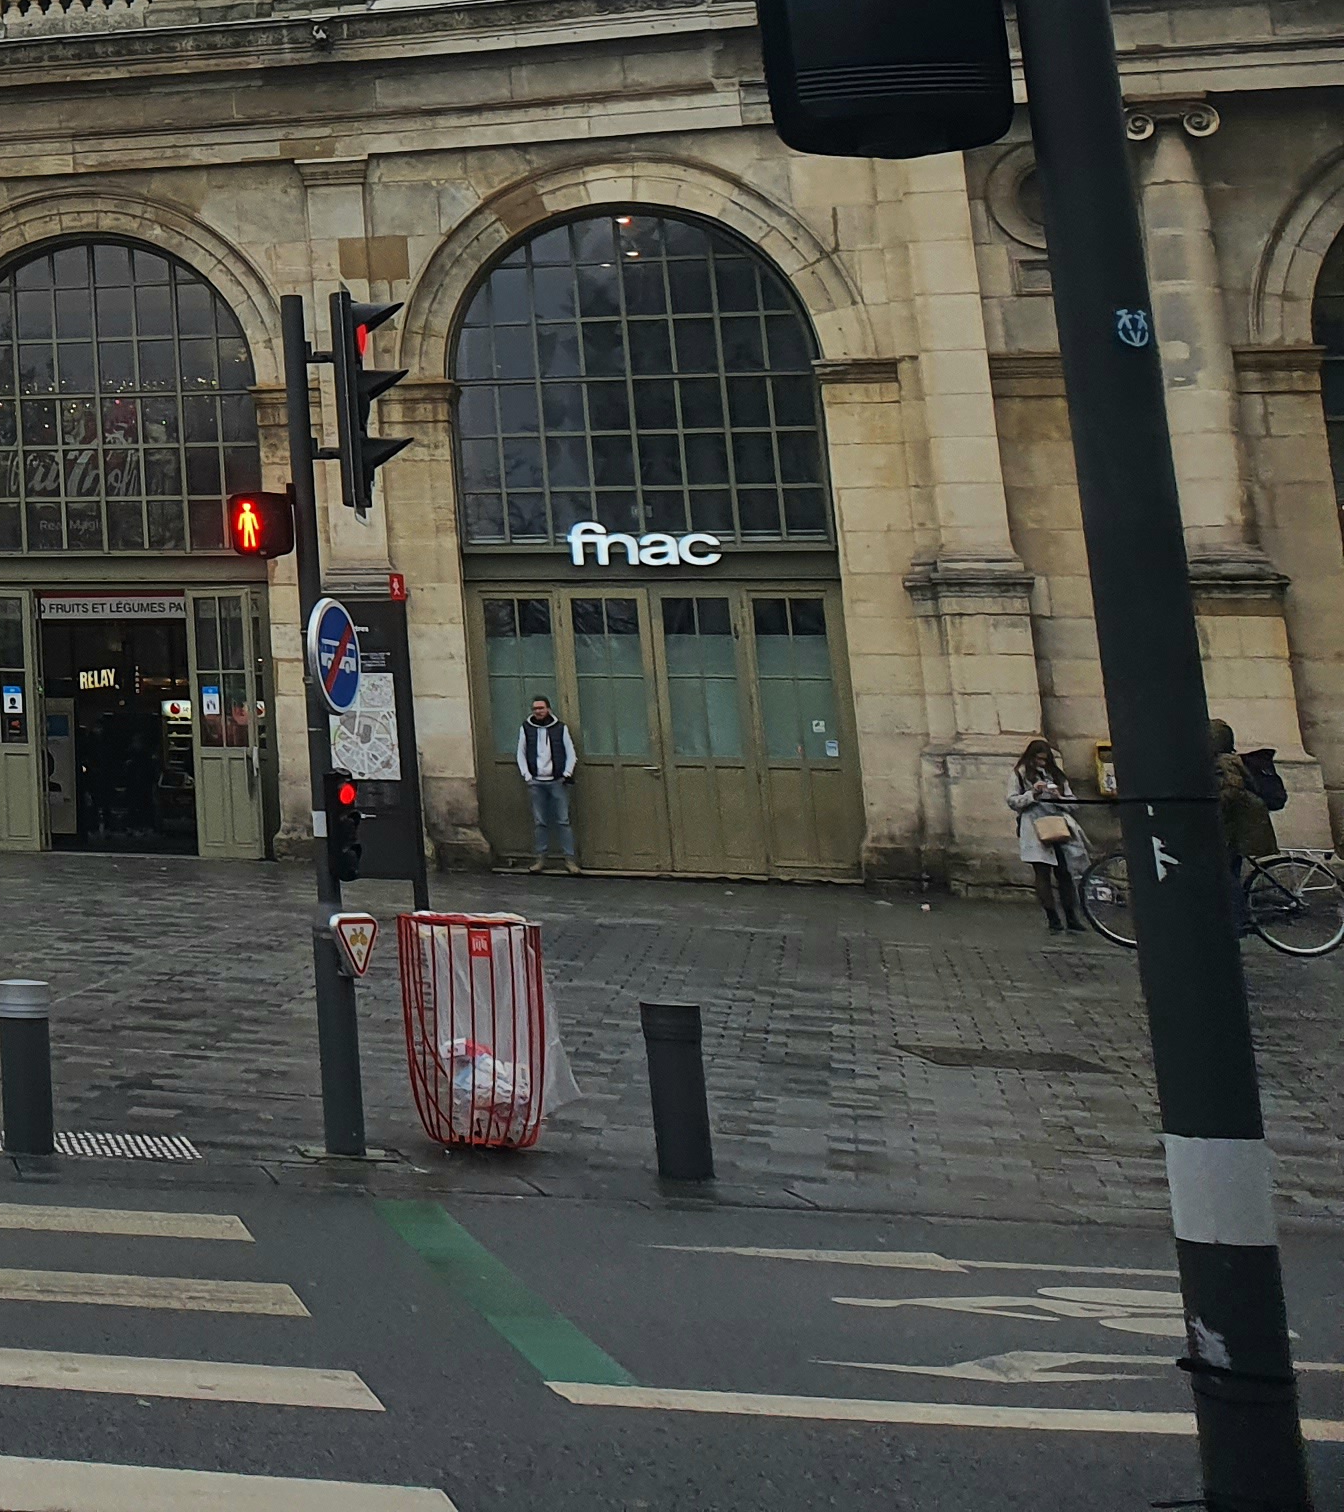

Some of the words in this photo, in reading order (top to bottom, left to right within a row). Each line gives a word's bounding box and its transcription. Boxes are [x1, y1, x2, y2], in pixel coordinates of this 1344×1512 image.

[567, 521, 723, 566] fnac
[49, 603, 89, 614] FRUITS
[91, 603, 107, 614] ET
[109, 601, 166, 613] LÉGUMES
[79, 668, 115, 690] RELAY
